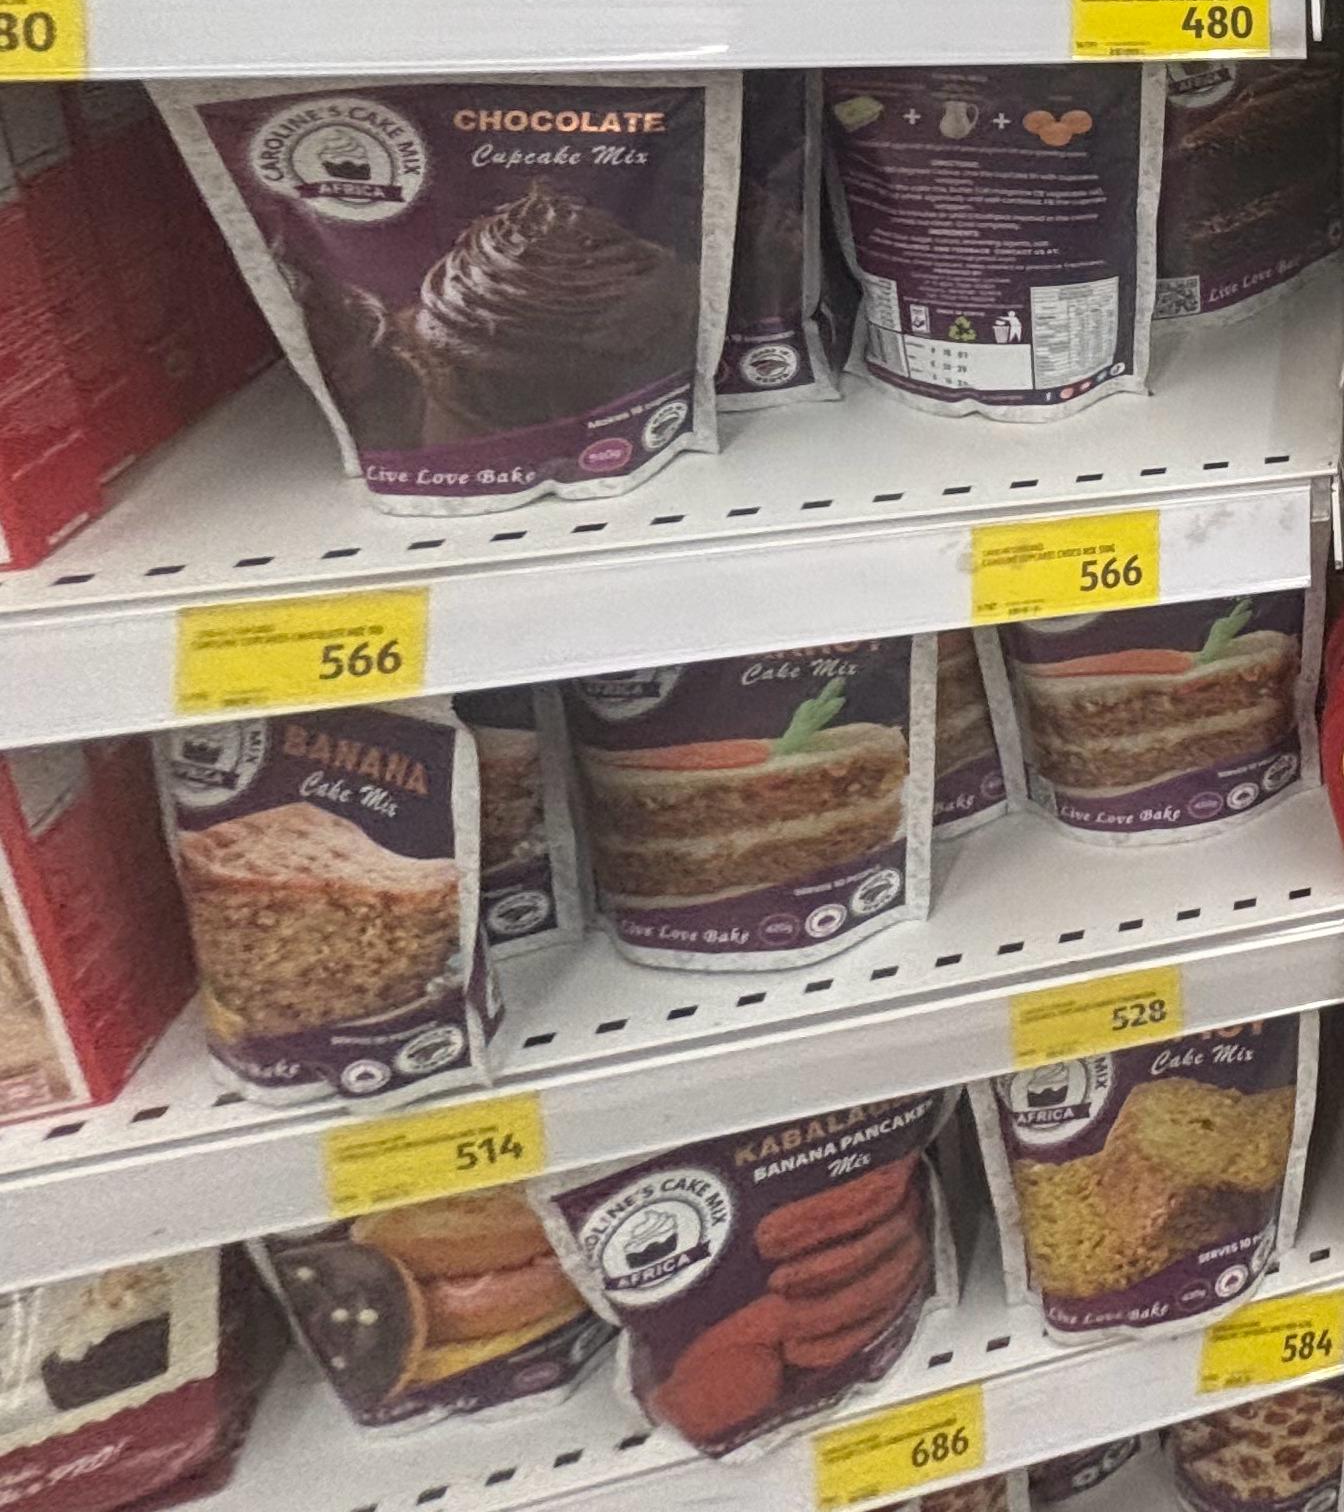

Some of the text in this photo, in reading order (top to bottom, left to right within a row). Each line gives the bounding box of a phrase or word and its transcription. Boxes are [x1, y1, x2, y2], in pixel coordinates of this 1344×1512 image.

[1182, 6, 1253, 39] 480
[453, 109, 666, 135] CHOCOLATE
[397, 140, 423, 178] MIX
[471, 143, 649, 170] Cupcake Mix
[416, 465, 538, 487] Love Bake
[1080, 554, 1144, 592] 566
[319, 640, 403, 680] 566
[740, 660, 802, 686] Cake
[283, 723, 431, 796] BANANA
[300, 772, 399, 818] Cake Mix
[1139, 803, 1181, 824] Bake
[1111, 1000, 1166, 1030] 528
[1150, 1046, 1254, 1076] Cake Mix
[1016, 1106, 1074, 1126] AFRICA
[455, 1131, 524, 1171] 514
[754, 1101, 931, 1182] BANANA PANCAKE
[829, 1152, 872, 1178] Mix
[617, 1252, 691, 1290] AFRICA
[1280, 1330, 1333, 1361] 584
[911, 1427, 969, 1468] 686
